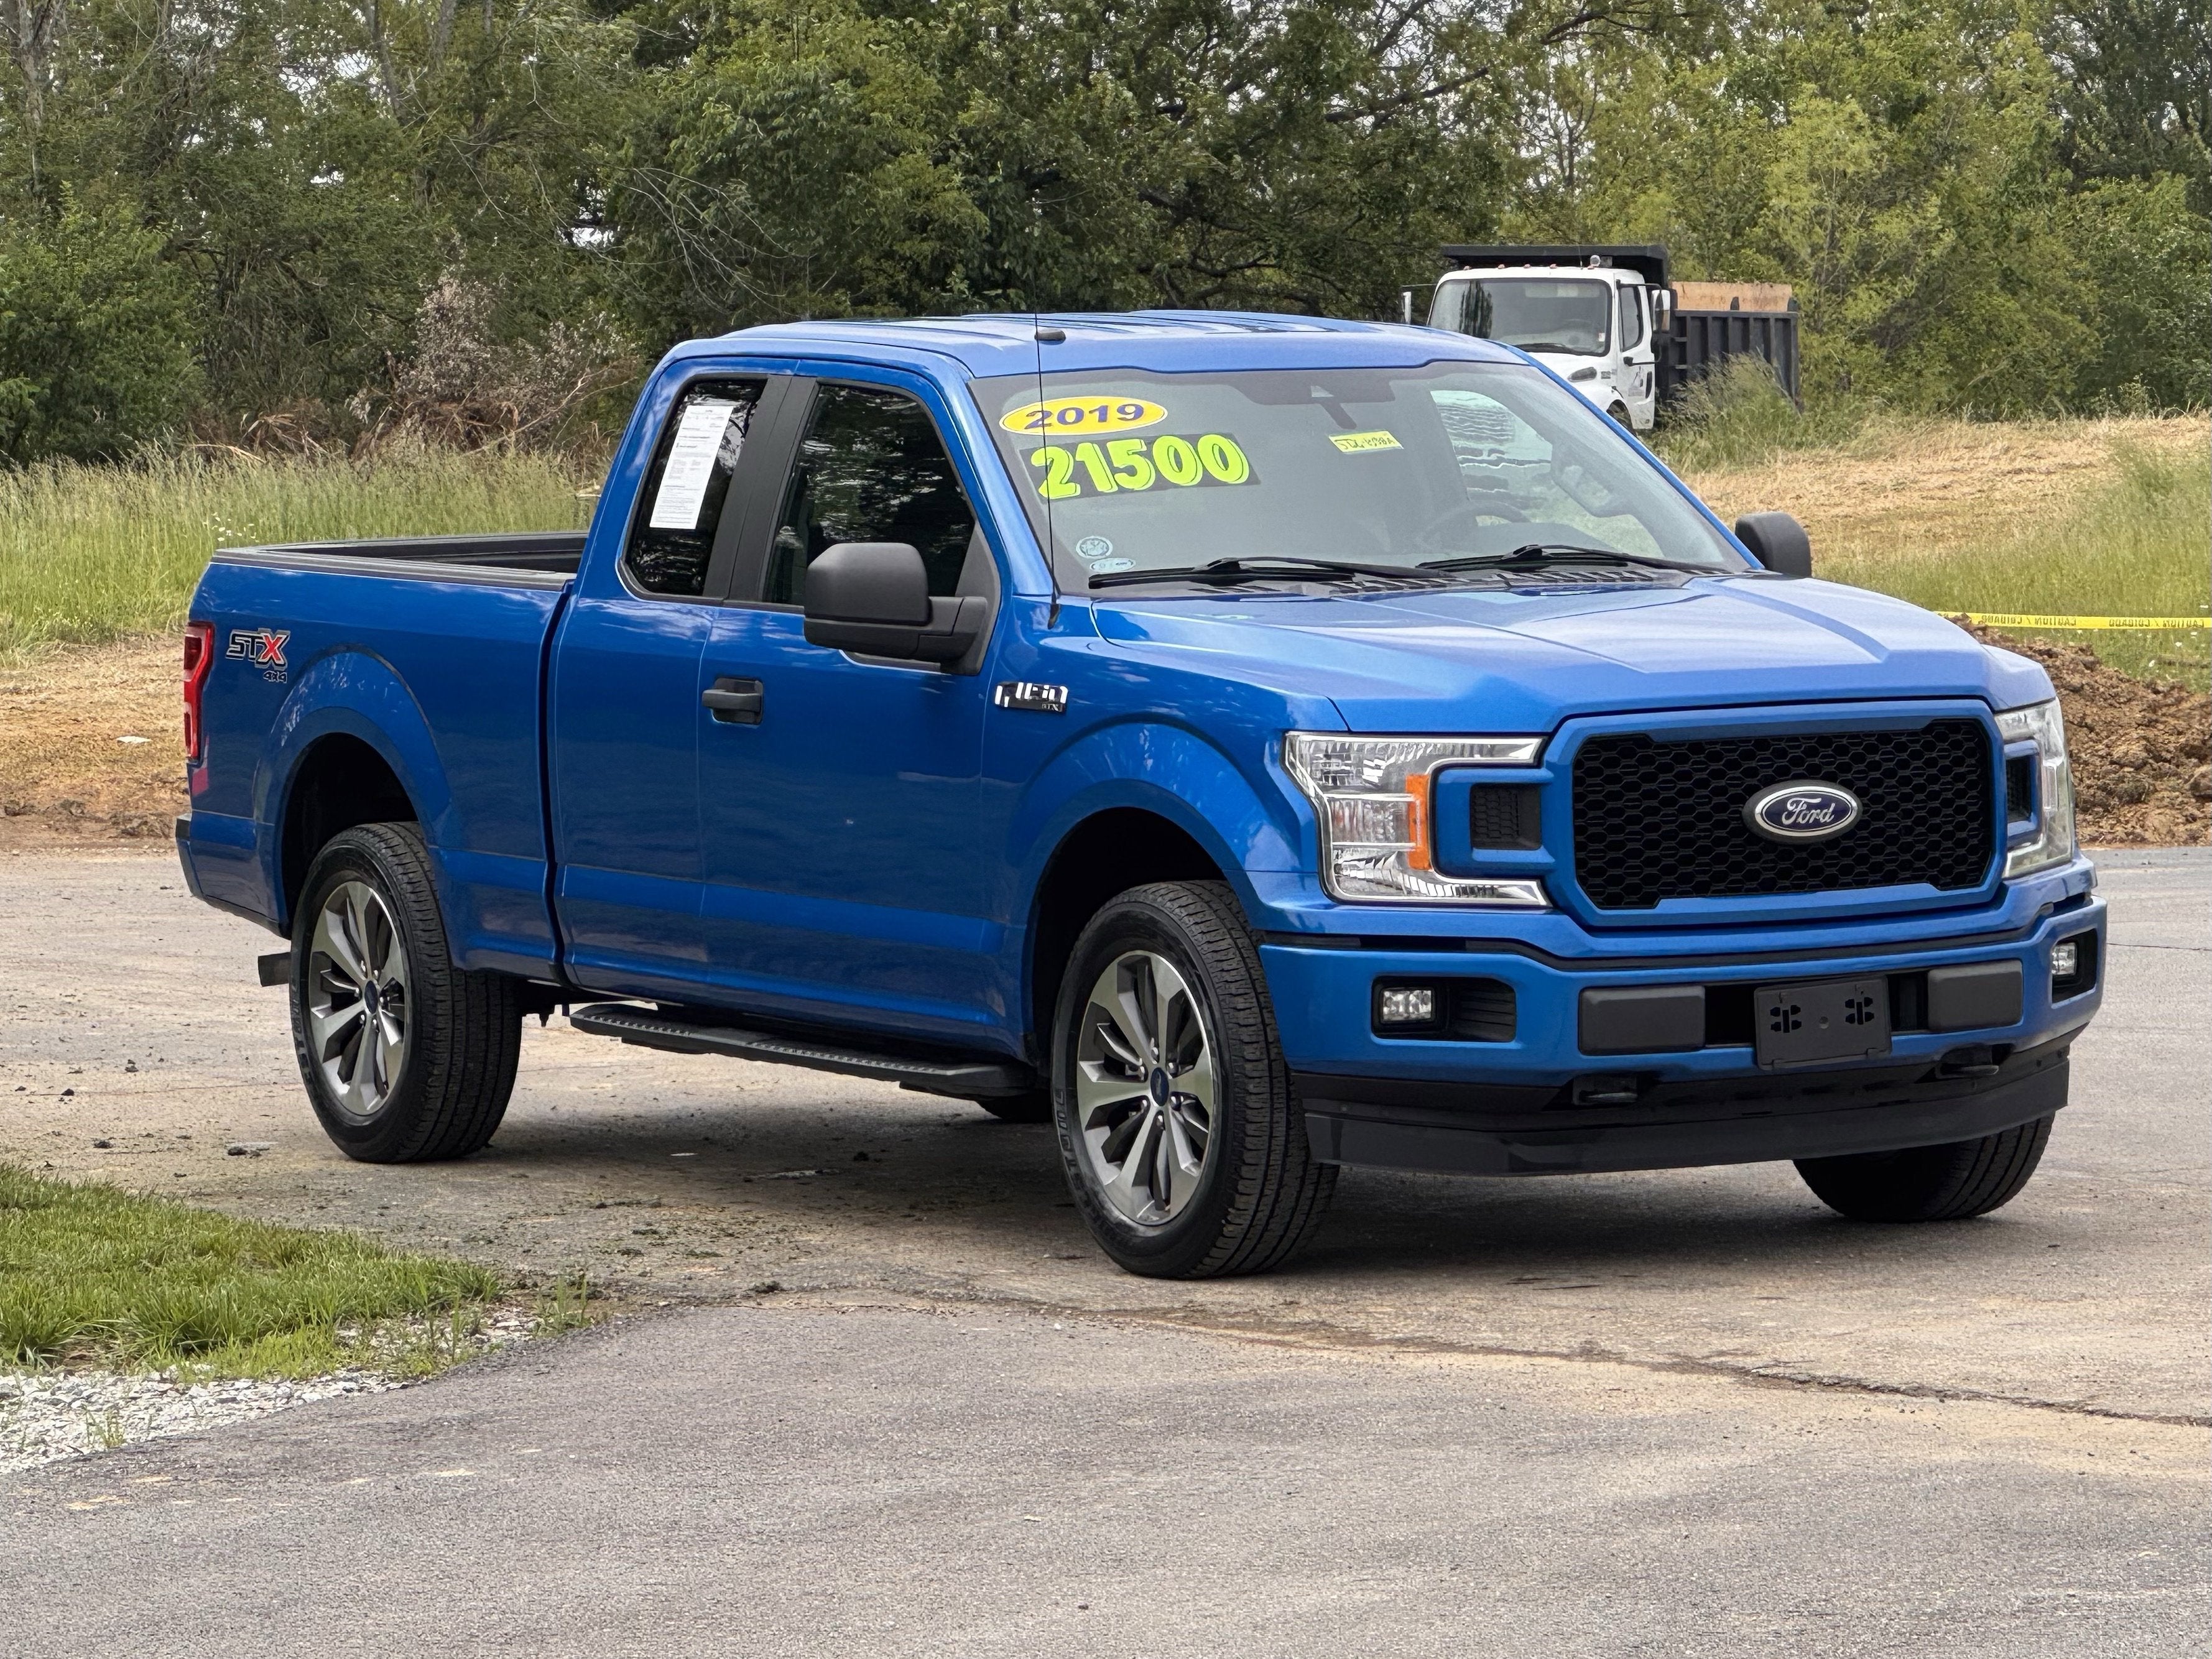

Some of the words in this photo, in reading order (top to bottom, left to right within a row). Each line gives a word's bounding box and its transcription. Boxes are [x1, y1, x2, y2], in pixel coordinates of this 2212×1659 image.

[1024, 404, 1145, 430] 2019
[1031, 434, 1249, 500] 21500
[226, 628, 290, 671] STX
[1782, 797, 1836, 825] Ford
